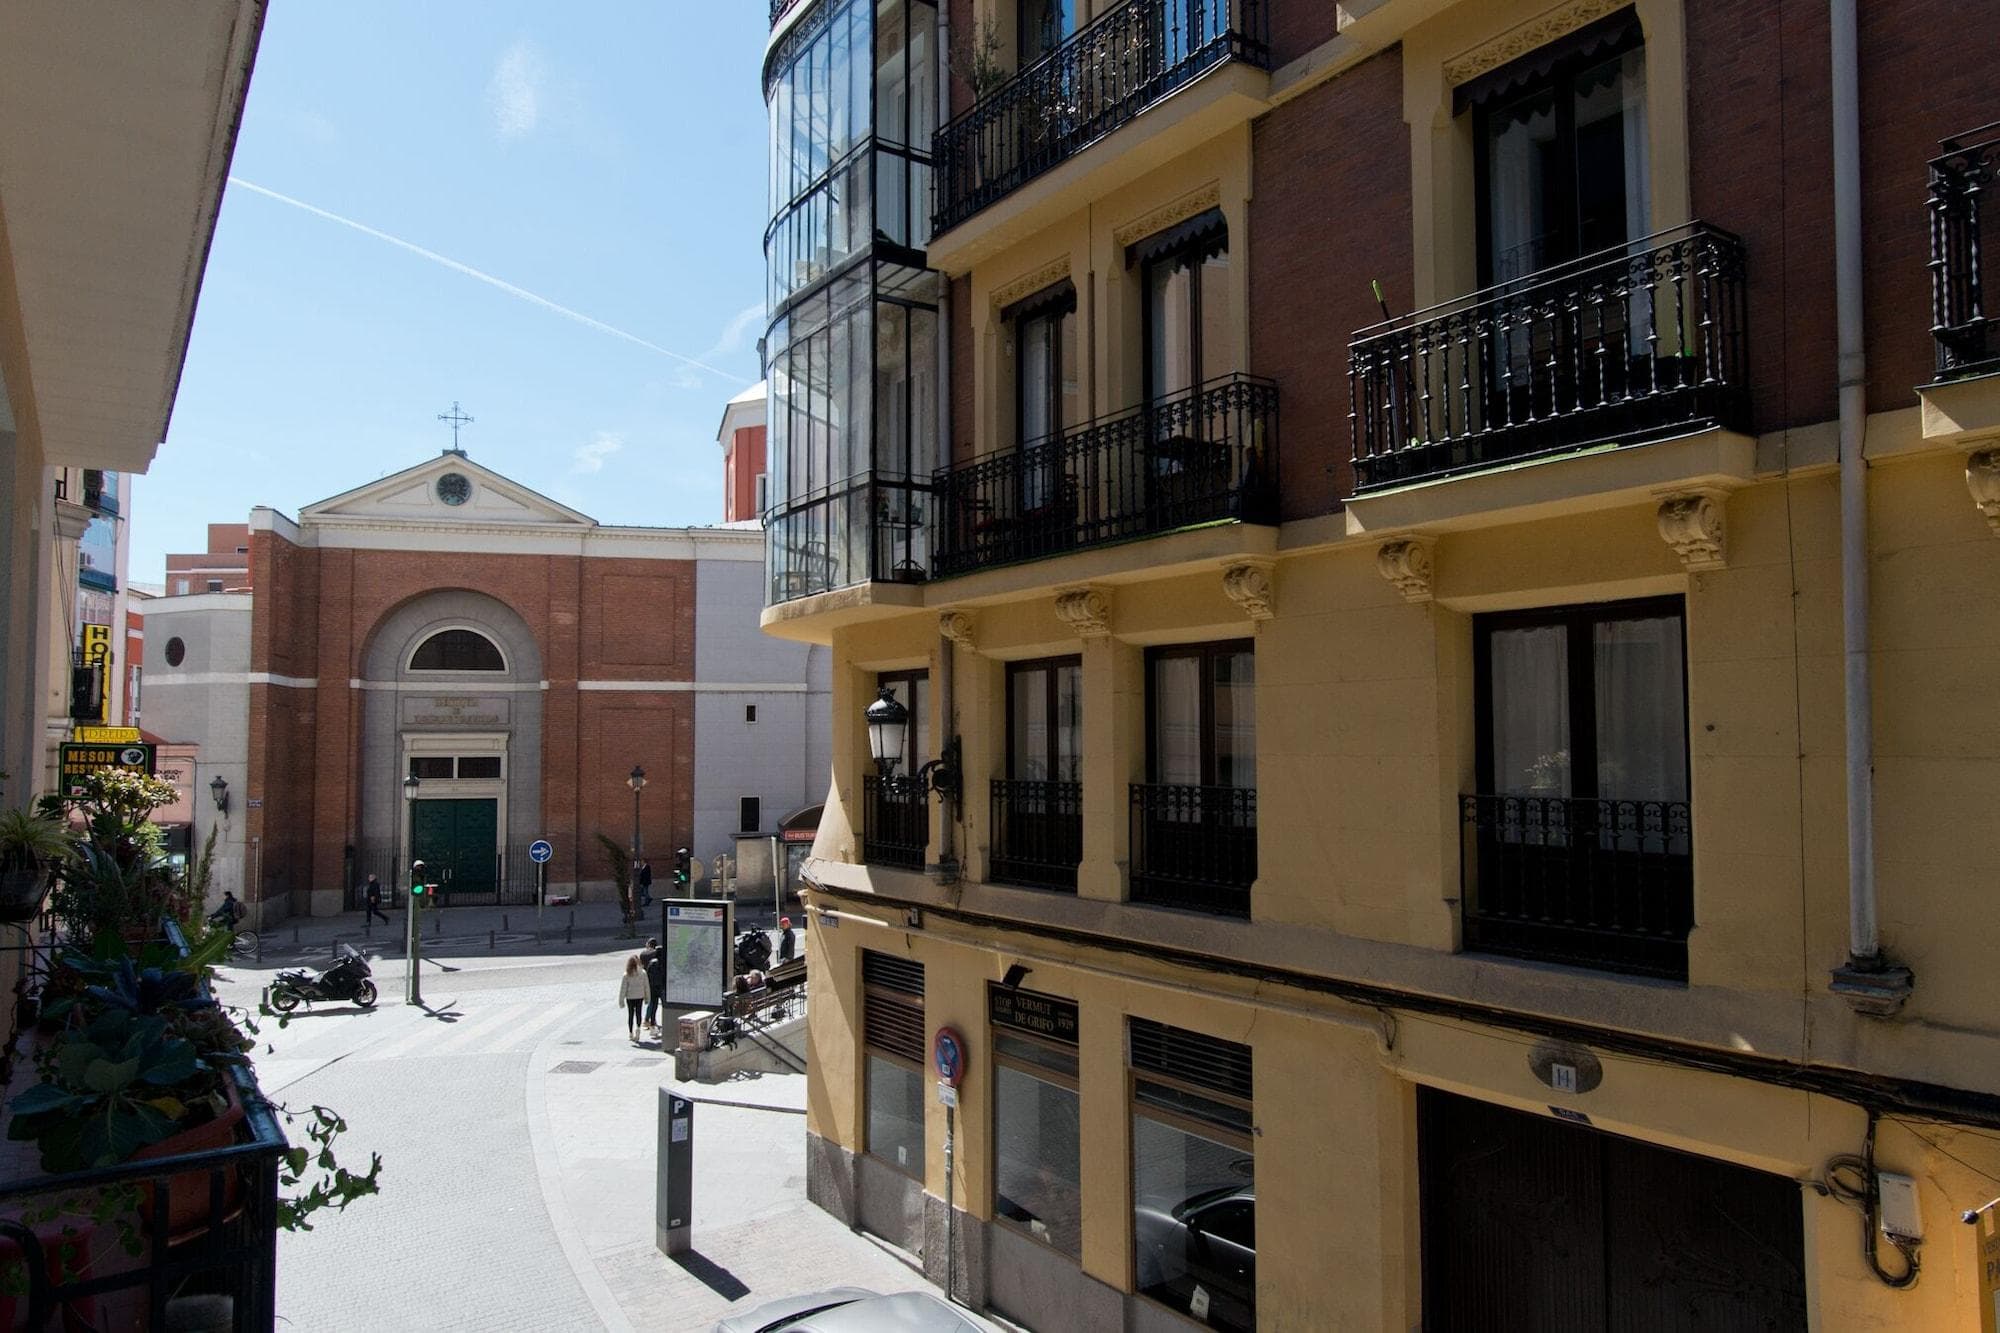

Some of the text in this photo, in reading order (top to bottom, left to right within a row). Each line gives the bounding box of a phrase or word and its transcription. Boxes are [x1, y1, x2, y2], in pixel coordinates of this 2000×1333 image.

[67, 751, 115, 762] MESON
[1016, 996, 1052, 1015] VERMUT
[1015, 1012, 1054, 1032] DE GRIFO
[674, 1100, 684, 1114] P
